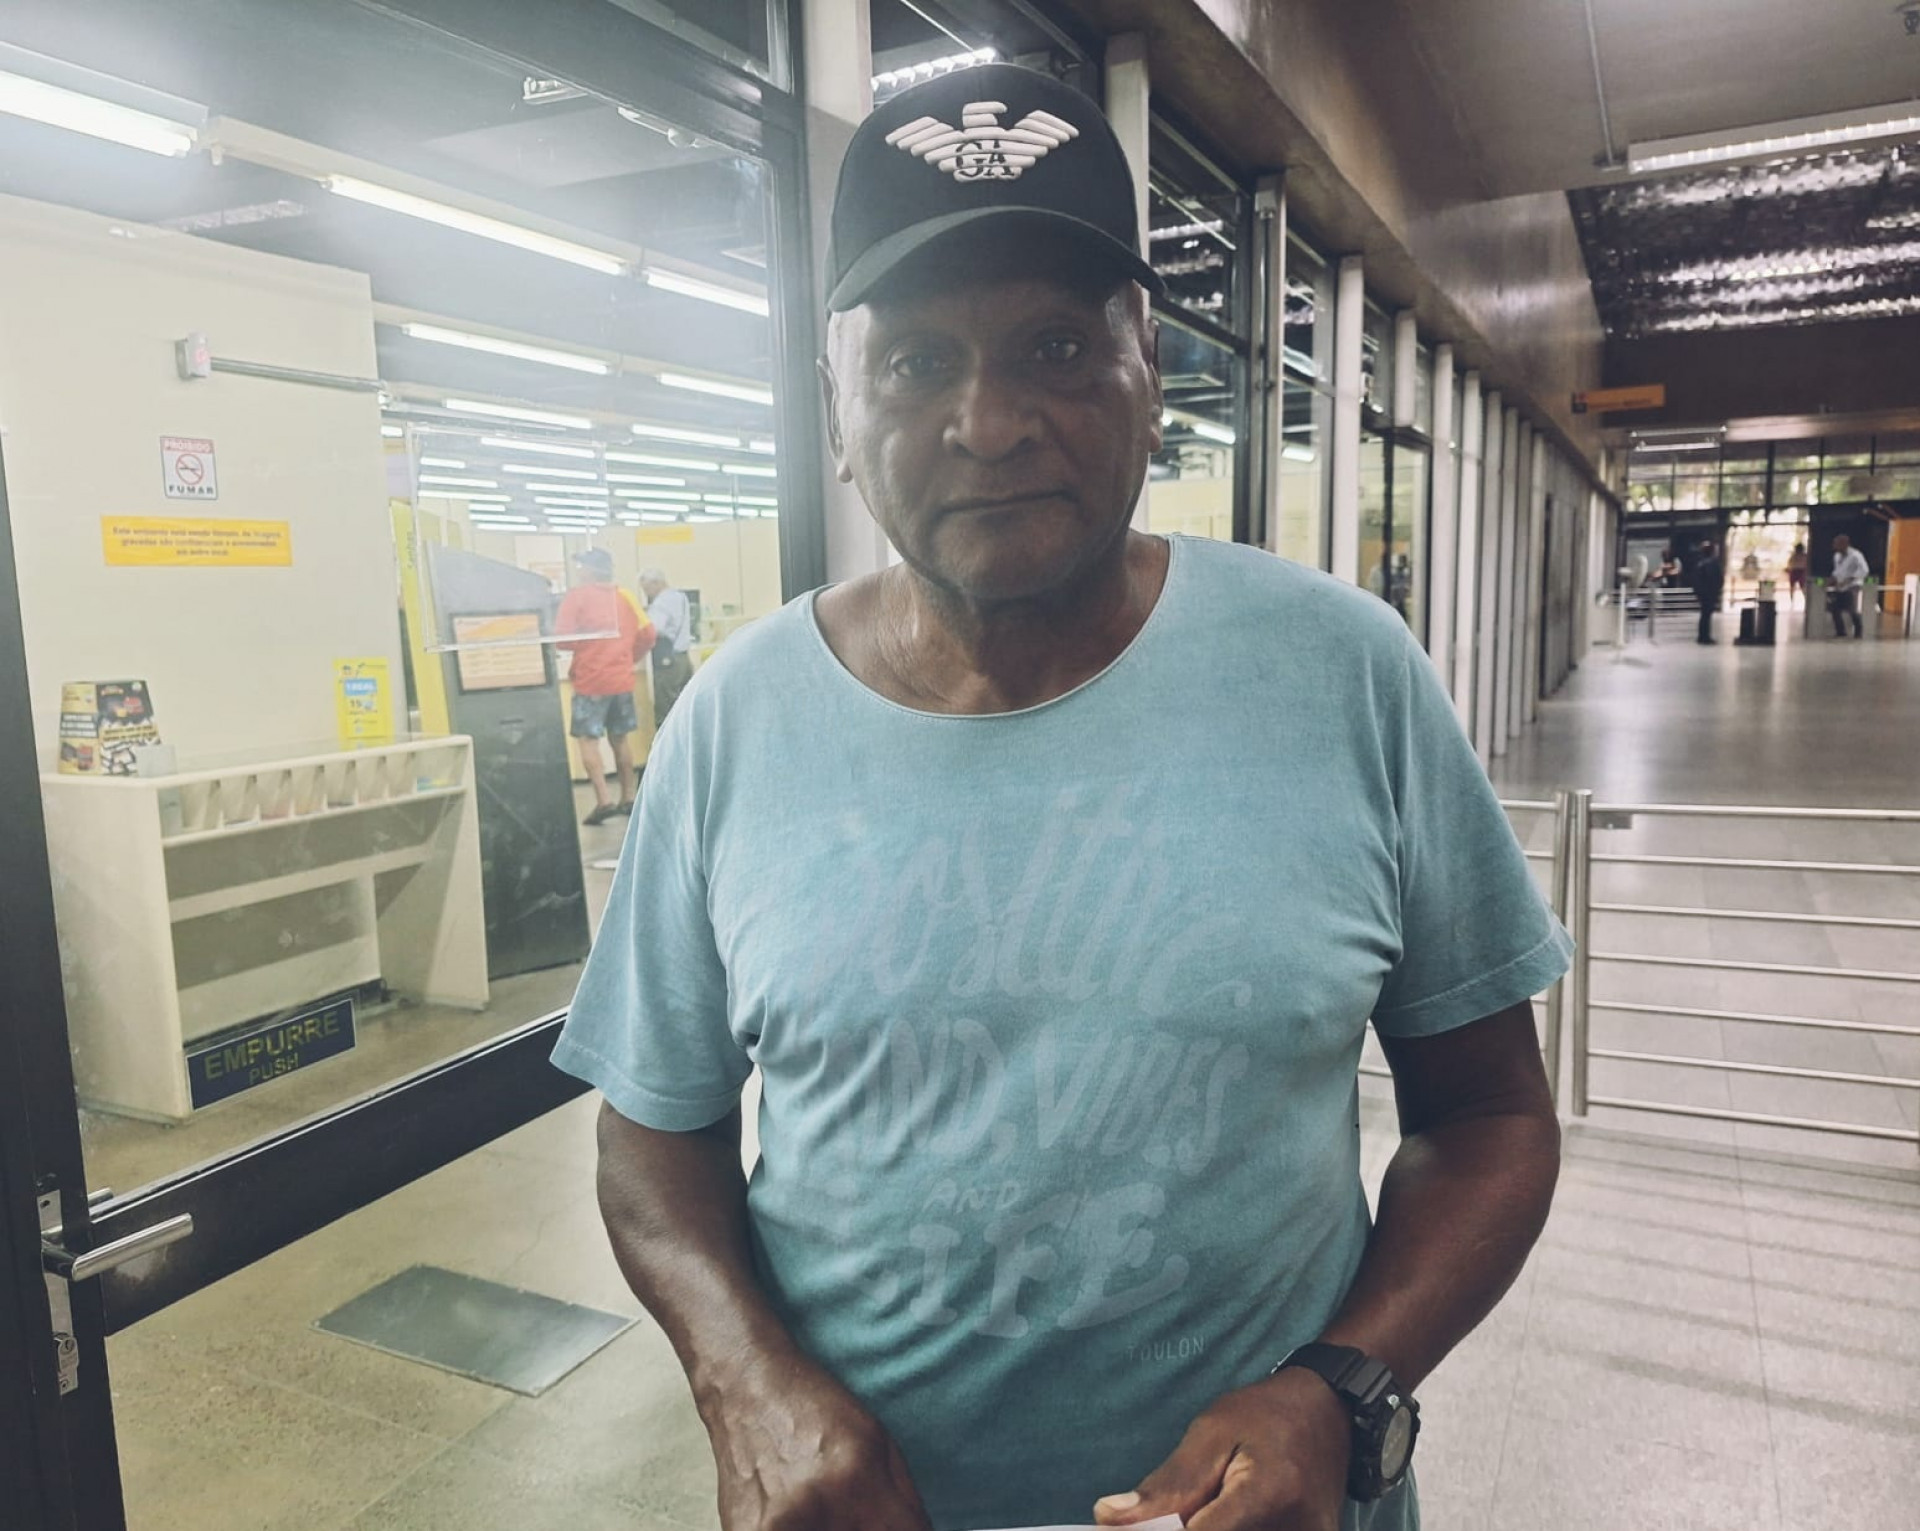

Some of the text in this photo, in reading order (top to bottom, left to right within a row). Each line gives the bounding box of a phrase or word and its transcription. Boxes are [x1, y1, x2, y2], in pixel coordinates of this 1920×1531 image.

[168, 484, 214, 495] FUMAR
[205, 1010, 340, 1080] EMPURRE
[250, 1052, 299, 1085] PUSH
